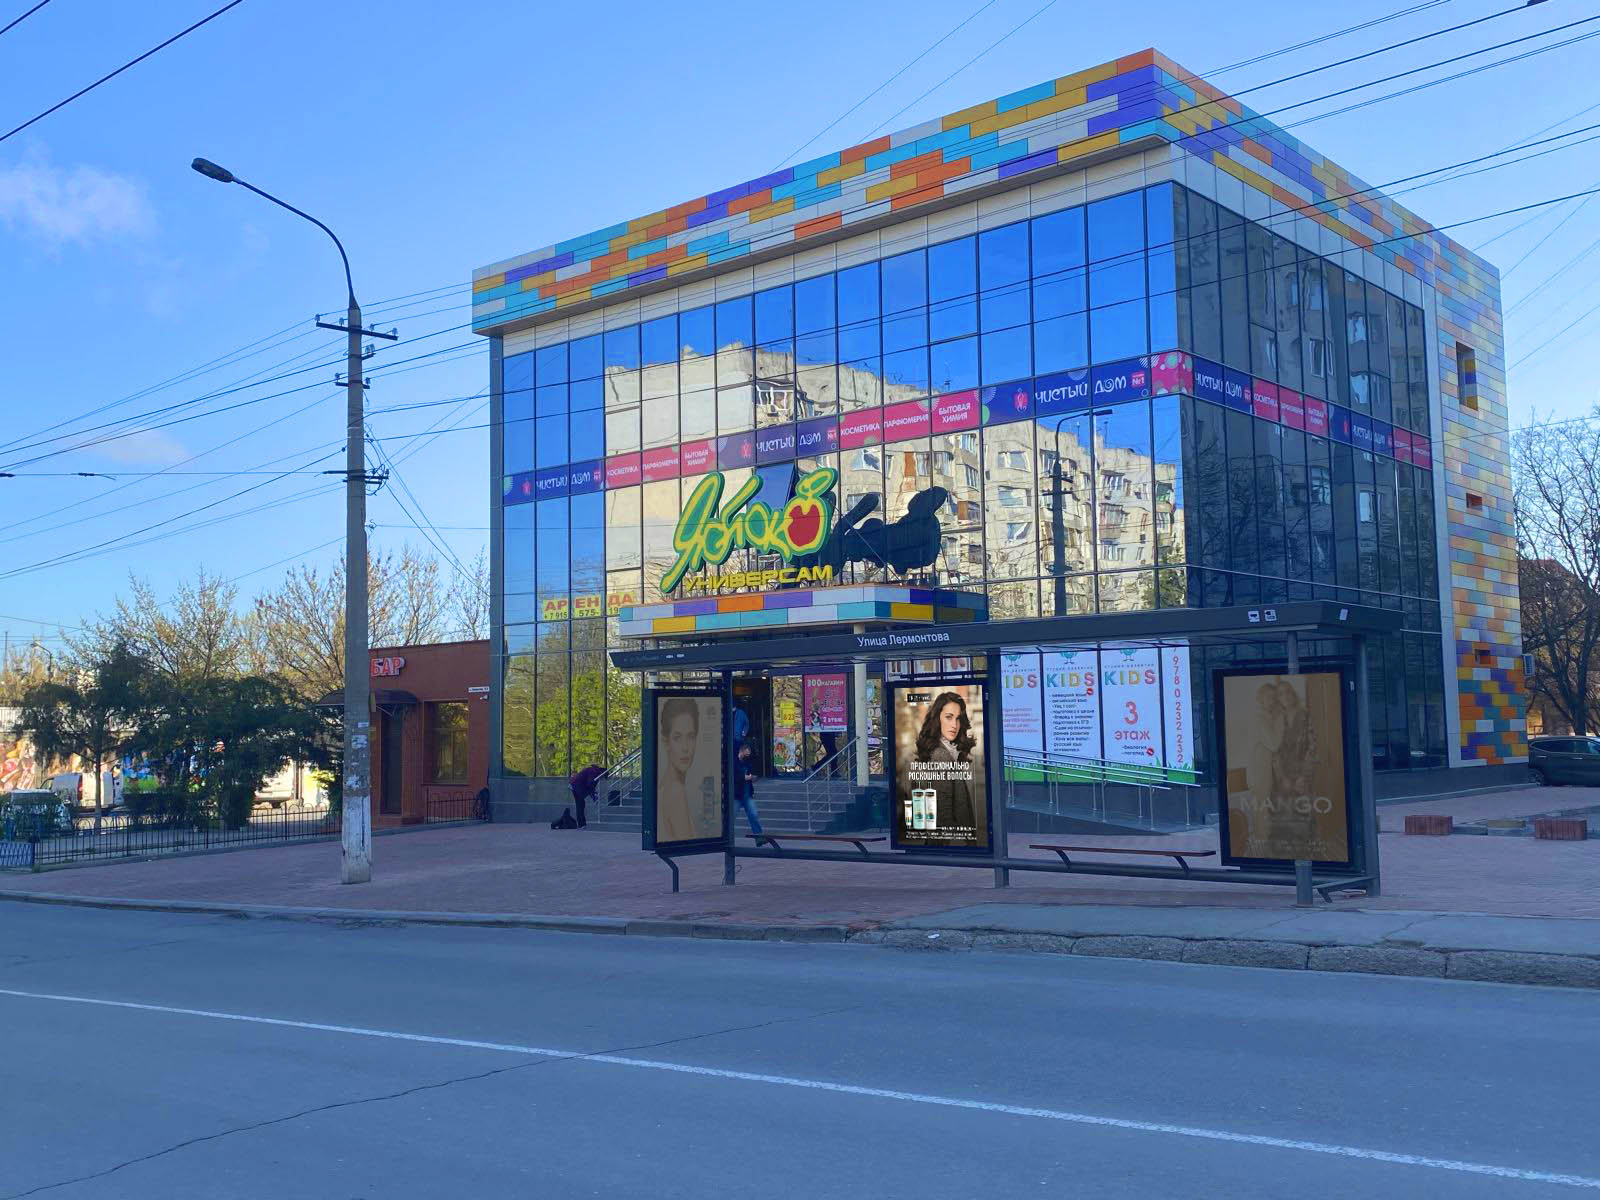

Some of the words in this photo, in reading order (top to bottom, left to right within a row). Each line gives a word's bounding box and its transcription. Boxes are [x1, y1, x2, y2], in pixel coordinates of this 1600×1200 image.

[1034, 381, 1088, 404] ЧИСТЫЙ
[1094, 375, 1127, 395] ДОМ
[1225, 381, 1242, 398] ДОМ
[938, 402, 971, 416] БЫТОВАЯ
[884, 413, 929, 428] ПАРФЮМЕРИЯ
[941, 412, 968, 424] ХИМИЯ
[840, 423, 880, 436] КОСМЕТИКА
[756, 436, 796, 453] ЧИСТЫЙ
[799, 431, 821, 446] ДОМ
[536, 476, 568, 491] ЧИСТЫЙ
[571, 472, 591, 485] ДОМ
[683, 564, 833, 592] УНИВЕРСАМ
[857, 636, 887, 648] Улица
[889, 632, 950, 646] Лермонтова
[371, 656, 405, 676] БАР
[1005, 673, 1037, 689] IDS
[1046, 671, 1095, 688] KIDS
[1104, 669, 1156, 686] KIDS
[1124, 700, 1139, 726] 3
[1114, 730, 1150, 741] этаж
[910, 761, 970, 771] ПРОФЕССИОНАЛЬНО
[908, 770, 946, 781] РОСКОШНЫЕ
[946, 770, 973, 781] ВОЛОСЫ
[1240, 795, 1333, 815] MANGO
